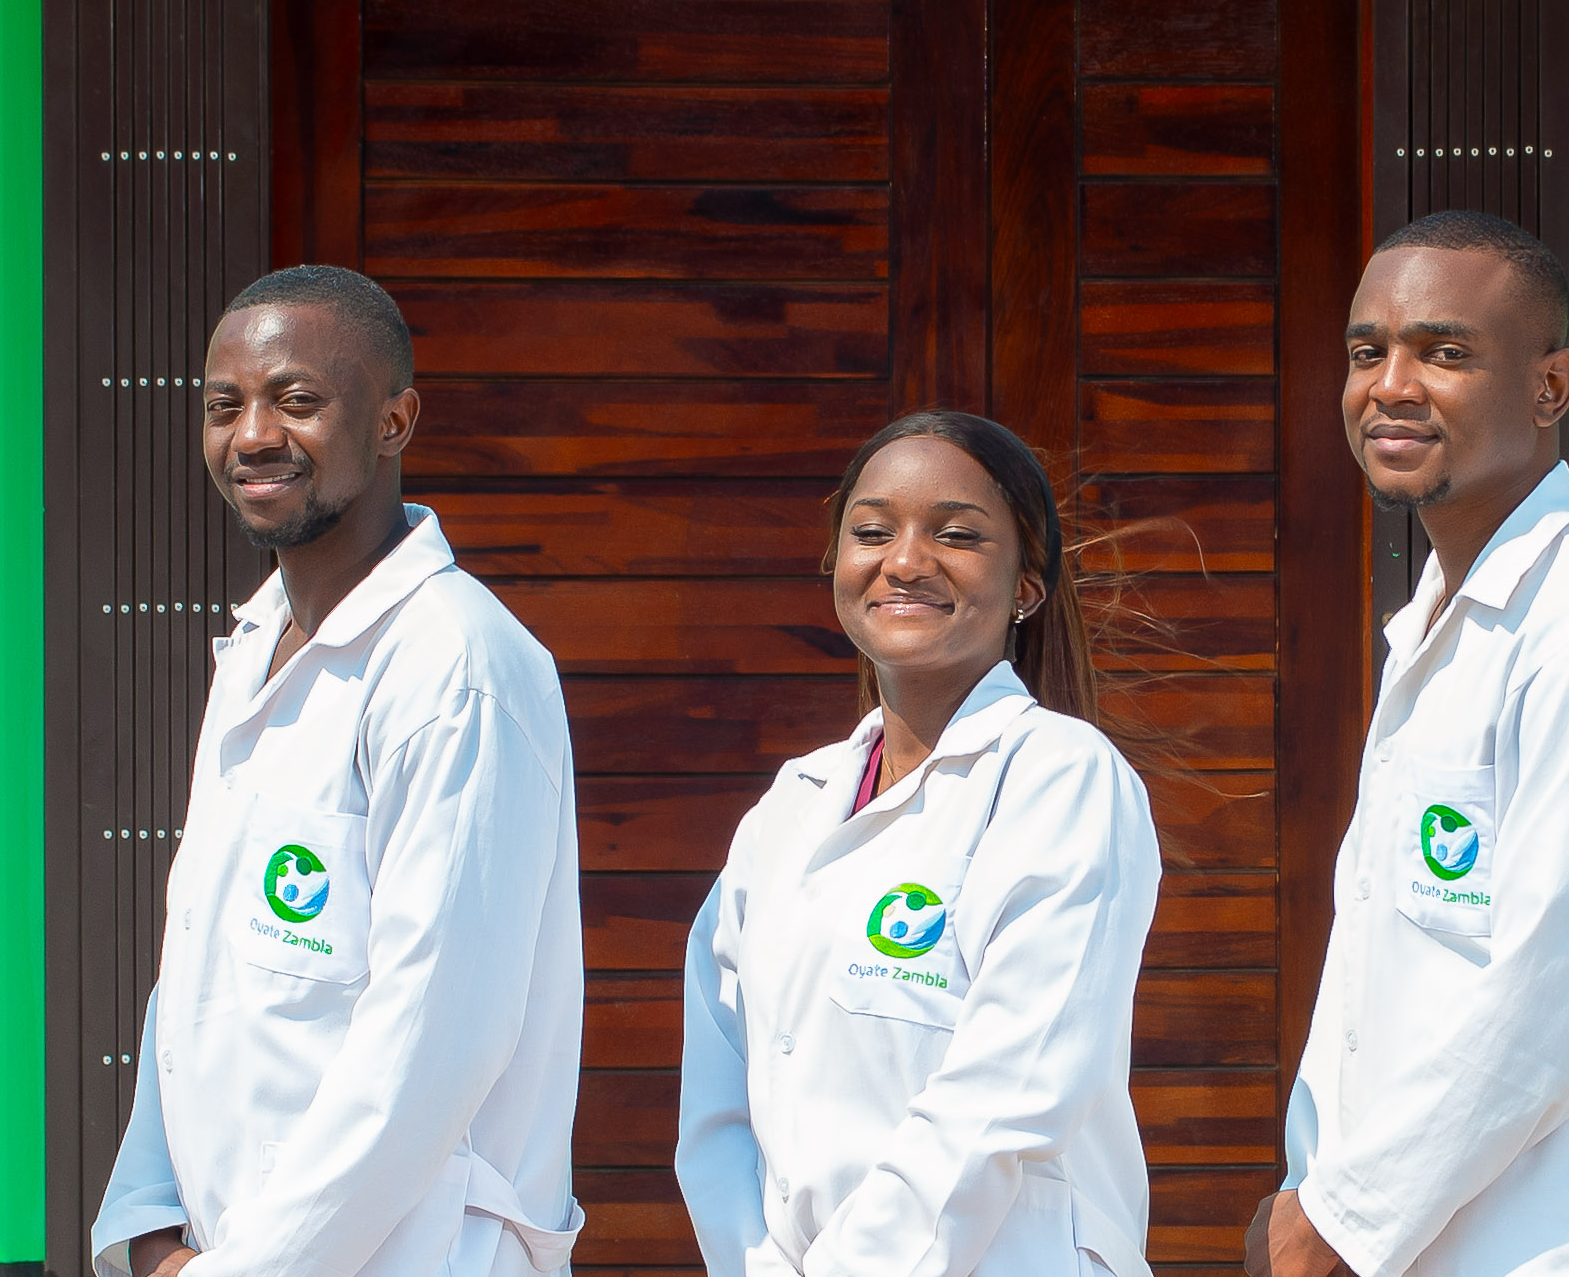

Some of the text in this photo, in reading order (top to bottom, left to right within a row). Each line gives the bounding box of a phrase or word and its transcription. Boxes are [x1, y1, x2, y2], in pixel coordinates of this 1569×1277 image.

[1411, 881, 1441, 898] Oyate
[249, 917, 333, 955] Oyate Zambia
[848, 963, 948, 989] Oyate Zambia
